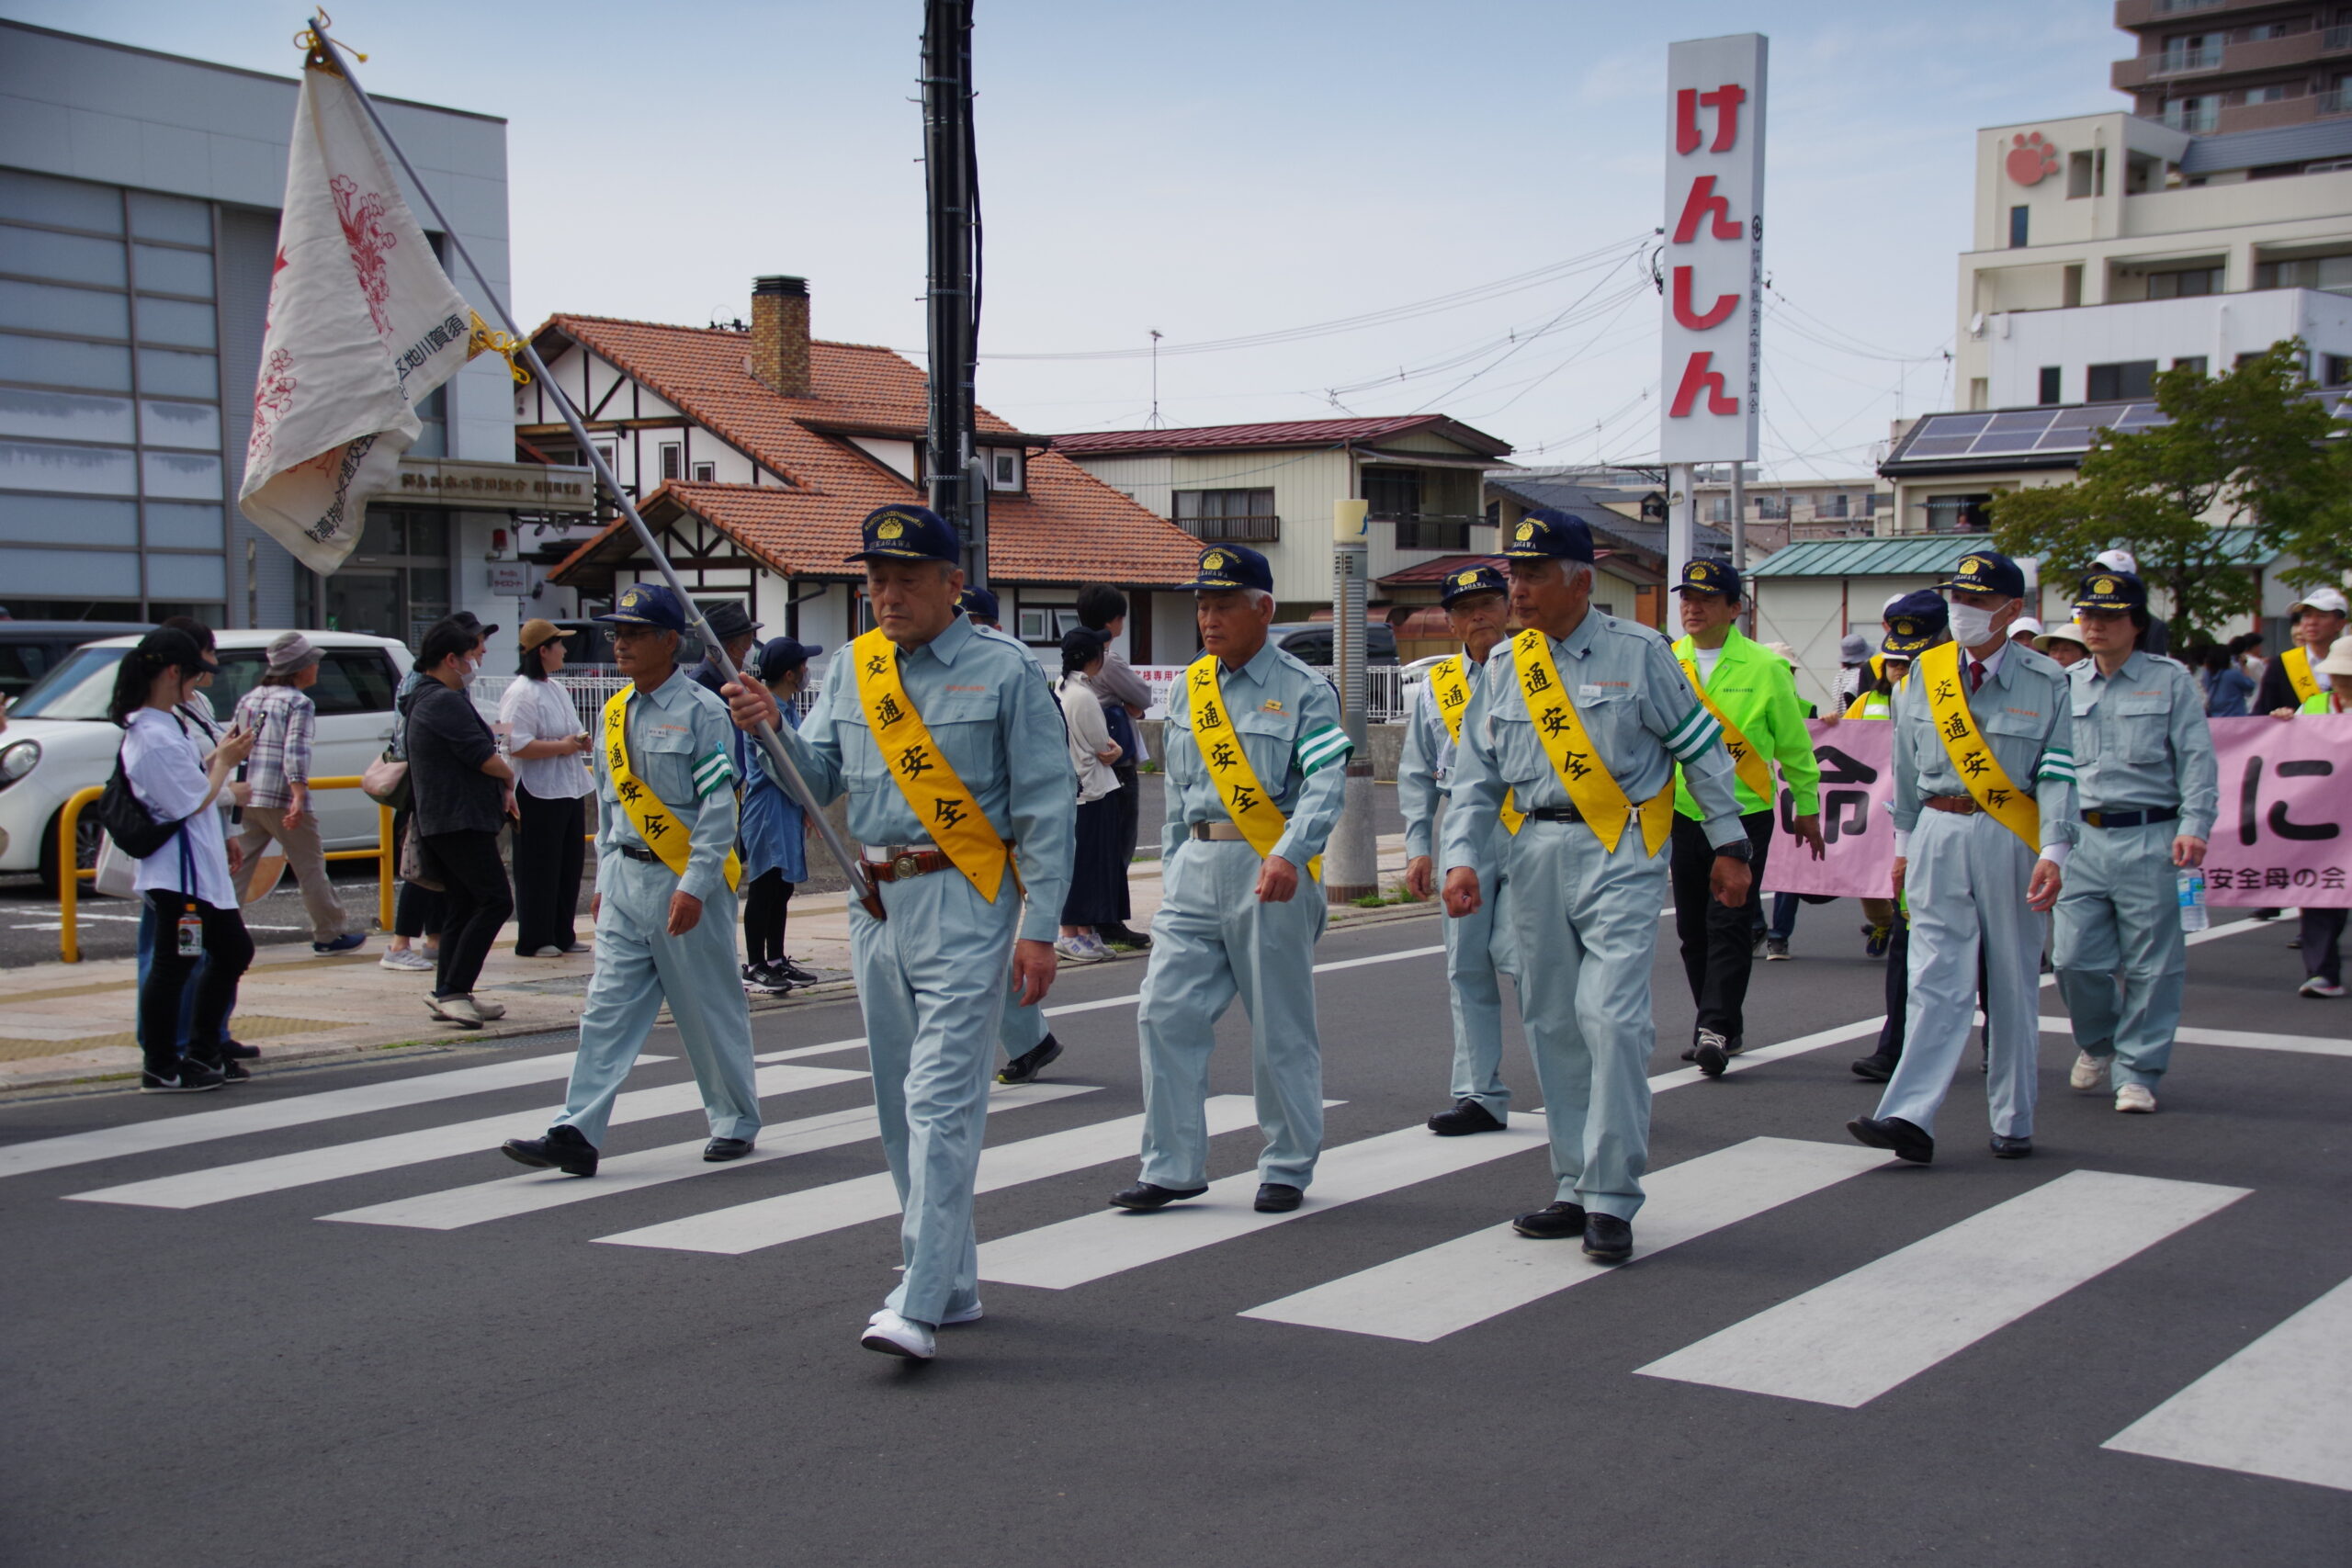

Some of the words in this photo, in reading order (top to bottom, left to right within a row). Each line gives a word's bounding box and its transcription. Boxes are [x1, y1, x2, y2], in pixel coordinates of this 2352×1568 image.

[1669, 84, 1746, 417] けんしん
[395, 314, 469, 400] 須賀川地区
[1135, 670, 1181, 682] 様専用
[1519, 631, 1591, 781] 交通安全
[608, 709, 670, 840] 交通安全
[866, 655, 967, 829] 交通安全
[1193, 669, 1260, 814] 交通安全
[1778, 745, 1878, 844] 命
[1934, 679, 2014, 808] 交通安全
[2239, 755, 2340, 847] に
